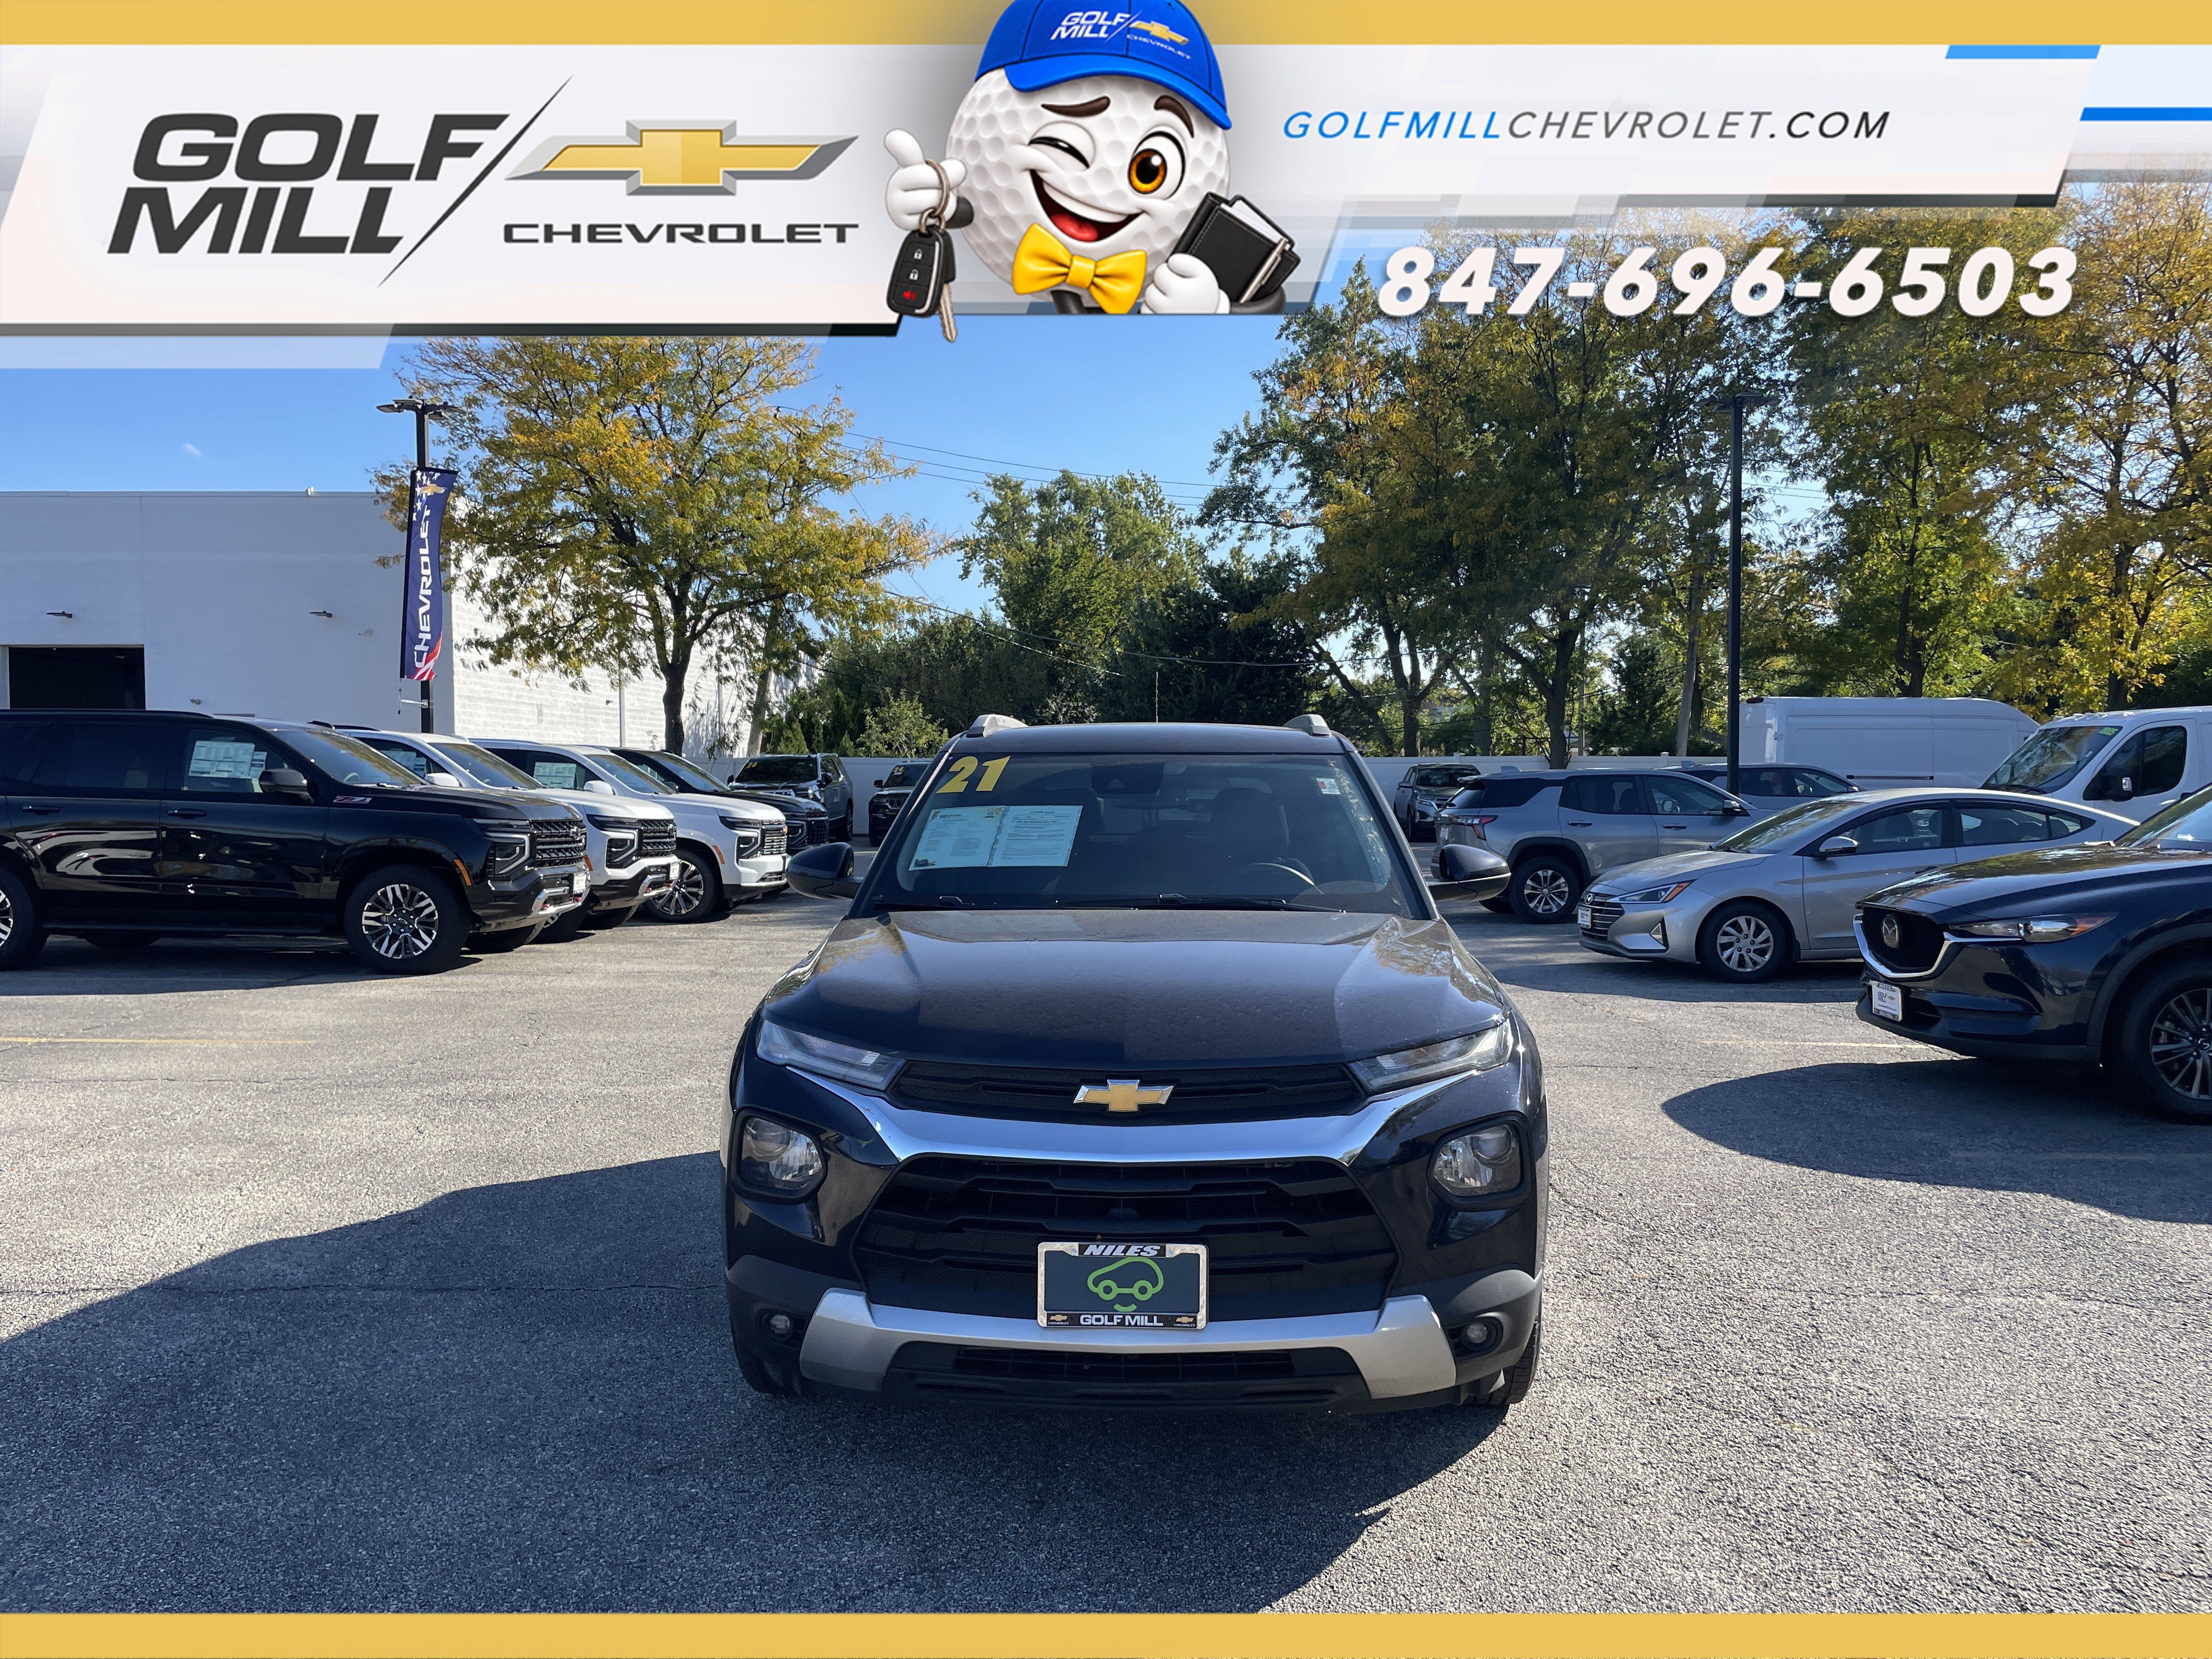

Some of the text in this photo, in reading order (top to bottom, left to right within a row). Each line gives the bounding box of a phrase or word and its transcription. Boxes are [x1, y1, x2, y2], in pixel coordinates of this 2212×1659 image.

[414, 505, 432, 668] CHEVROLET
[936, 756, 1011, 793] 21
[1083, 1244, 1161, 1257] NILES
[1080, 1314, 1164, 1326] GOLF MILL
